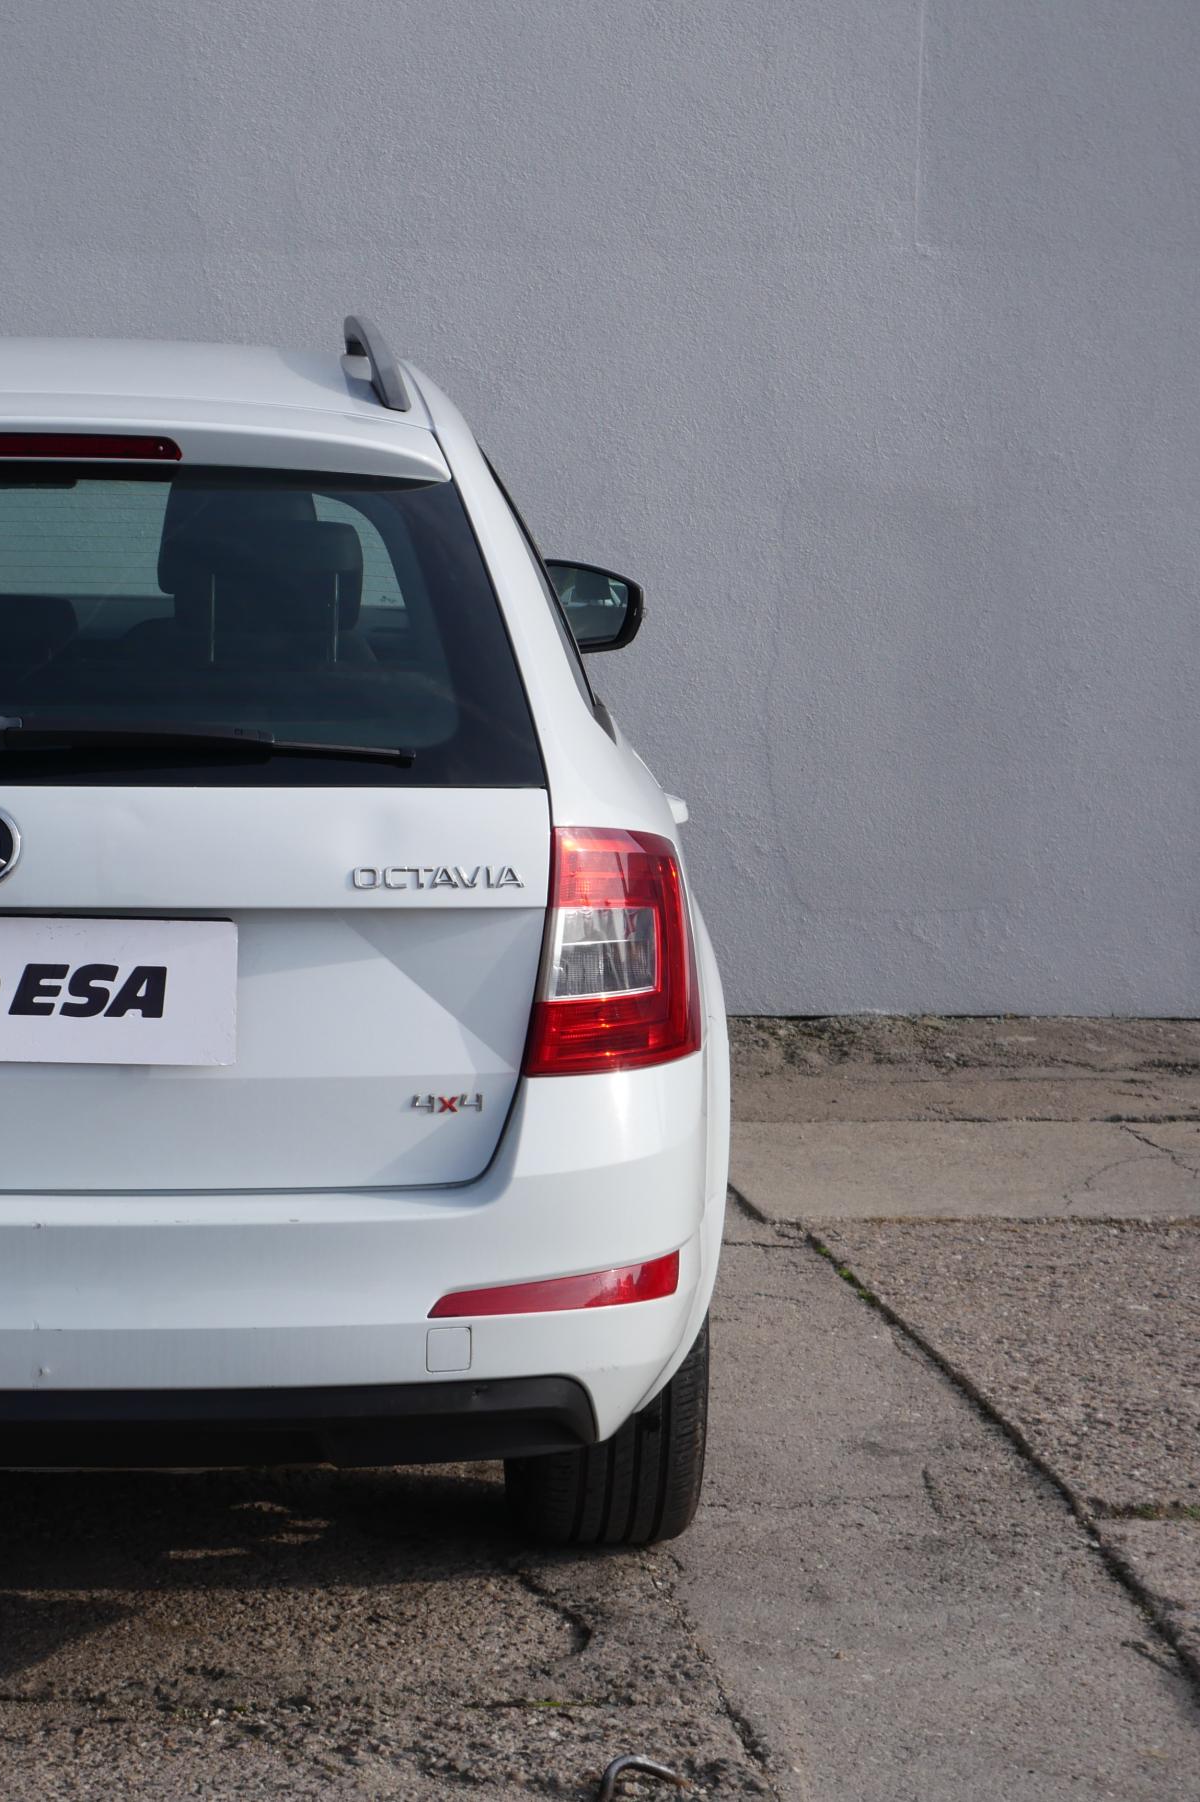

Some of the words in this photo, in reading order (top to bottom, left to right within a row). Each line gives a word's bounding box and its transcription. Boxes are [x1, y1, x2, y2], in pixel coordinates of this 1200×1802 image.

[353, 866, 525, 889] OCTAVIA
[8, 962, 168, 1019] ESA
[411, 1093, 482, 1113] 4x4
